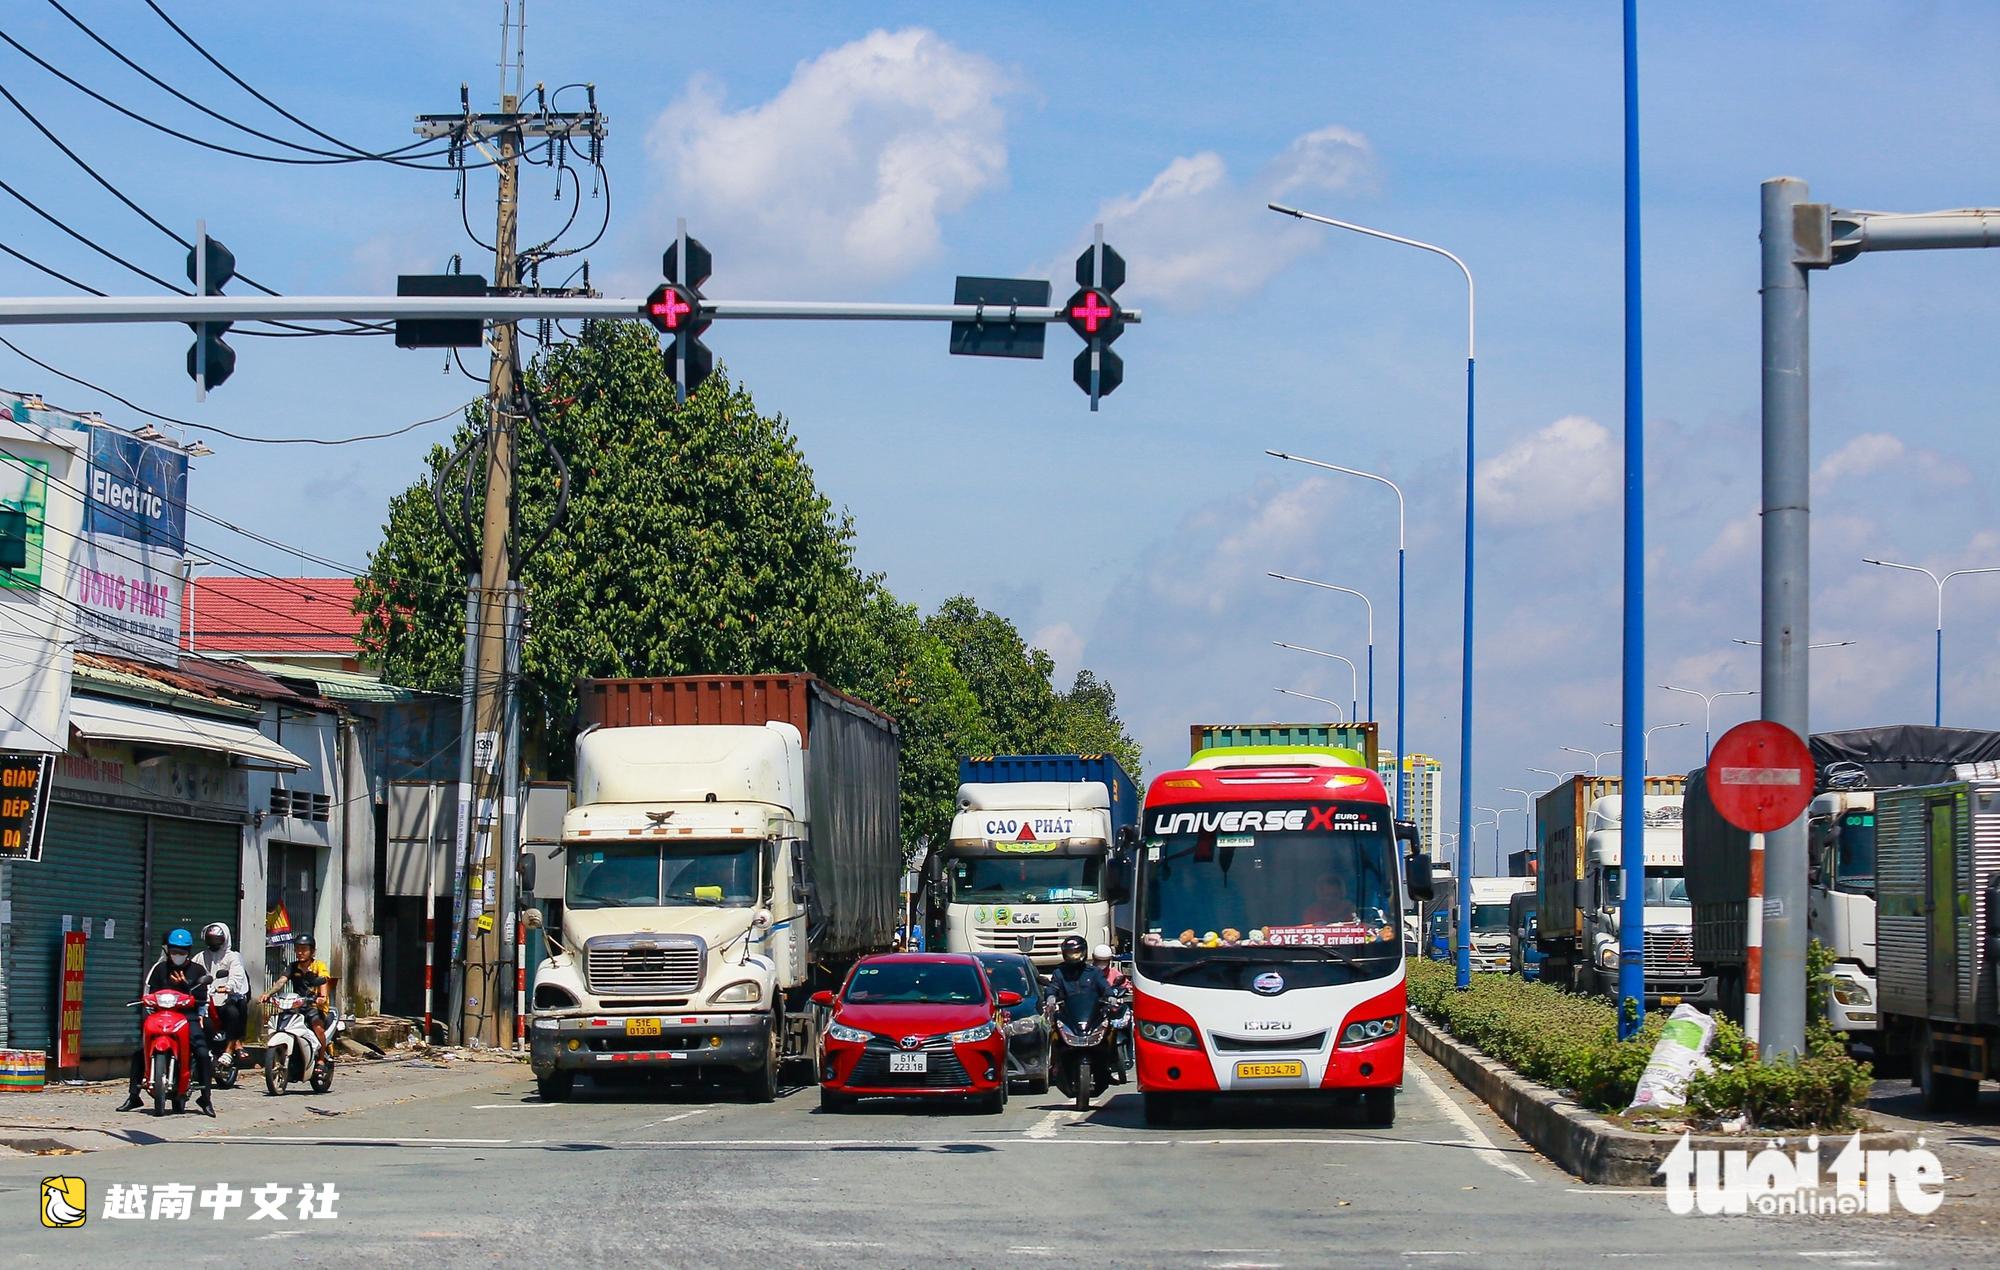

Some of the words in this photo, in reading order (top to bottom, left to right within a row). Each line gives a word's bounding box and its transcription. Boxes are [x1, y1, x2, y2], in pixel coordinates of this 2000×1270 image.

[93, 469, 162, 519] Electric
[3, 766, 36, 788] GIÀY
[2, 796, 29, 818] DÉP
[986, 819, 1018, 835] CAO
[1034, 816, 1074, 834] PHÁT
[1155, 810, 1307, 834] UNIVERSE
[1306, 806, 1338, 831] X
[1334, 822, 1378, 832] mini
[3, 829, 21, 848] DA
[1012, 912, 1040, 924] C&C
[1300, 933, 1325, 945] 33
[635, 1018, 651, 1027] 51E
[1244, 1021, 1292, 1031] ISUZU
[900, 1054, 917, 1063] 61K
[894, 1063, 923, 1072] 223.18
[1243, 1065, 1297, 1075] 61E-034.78
